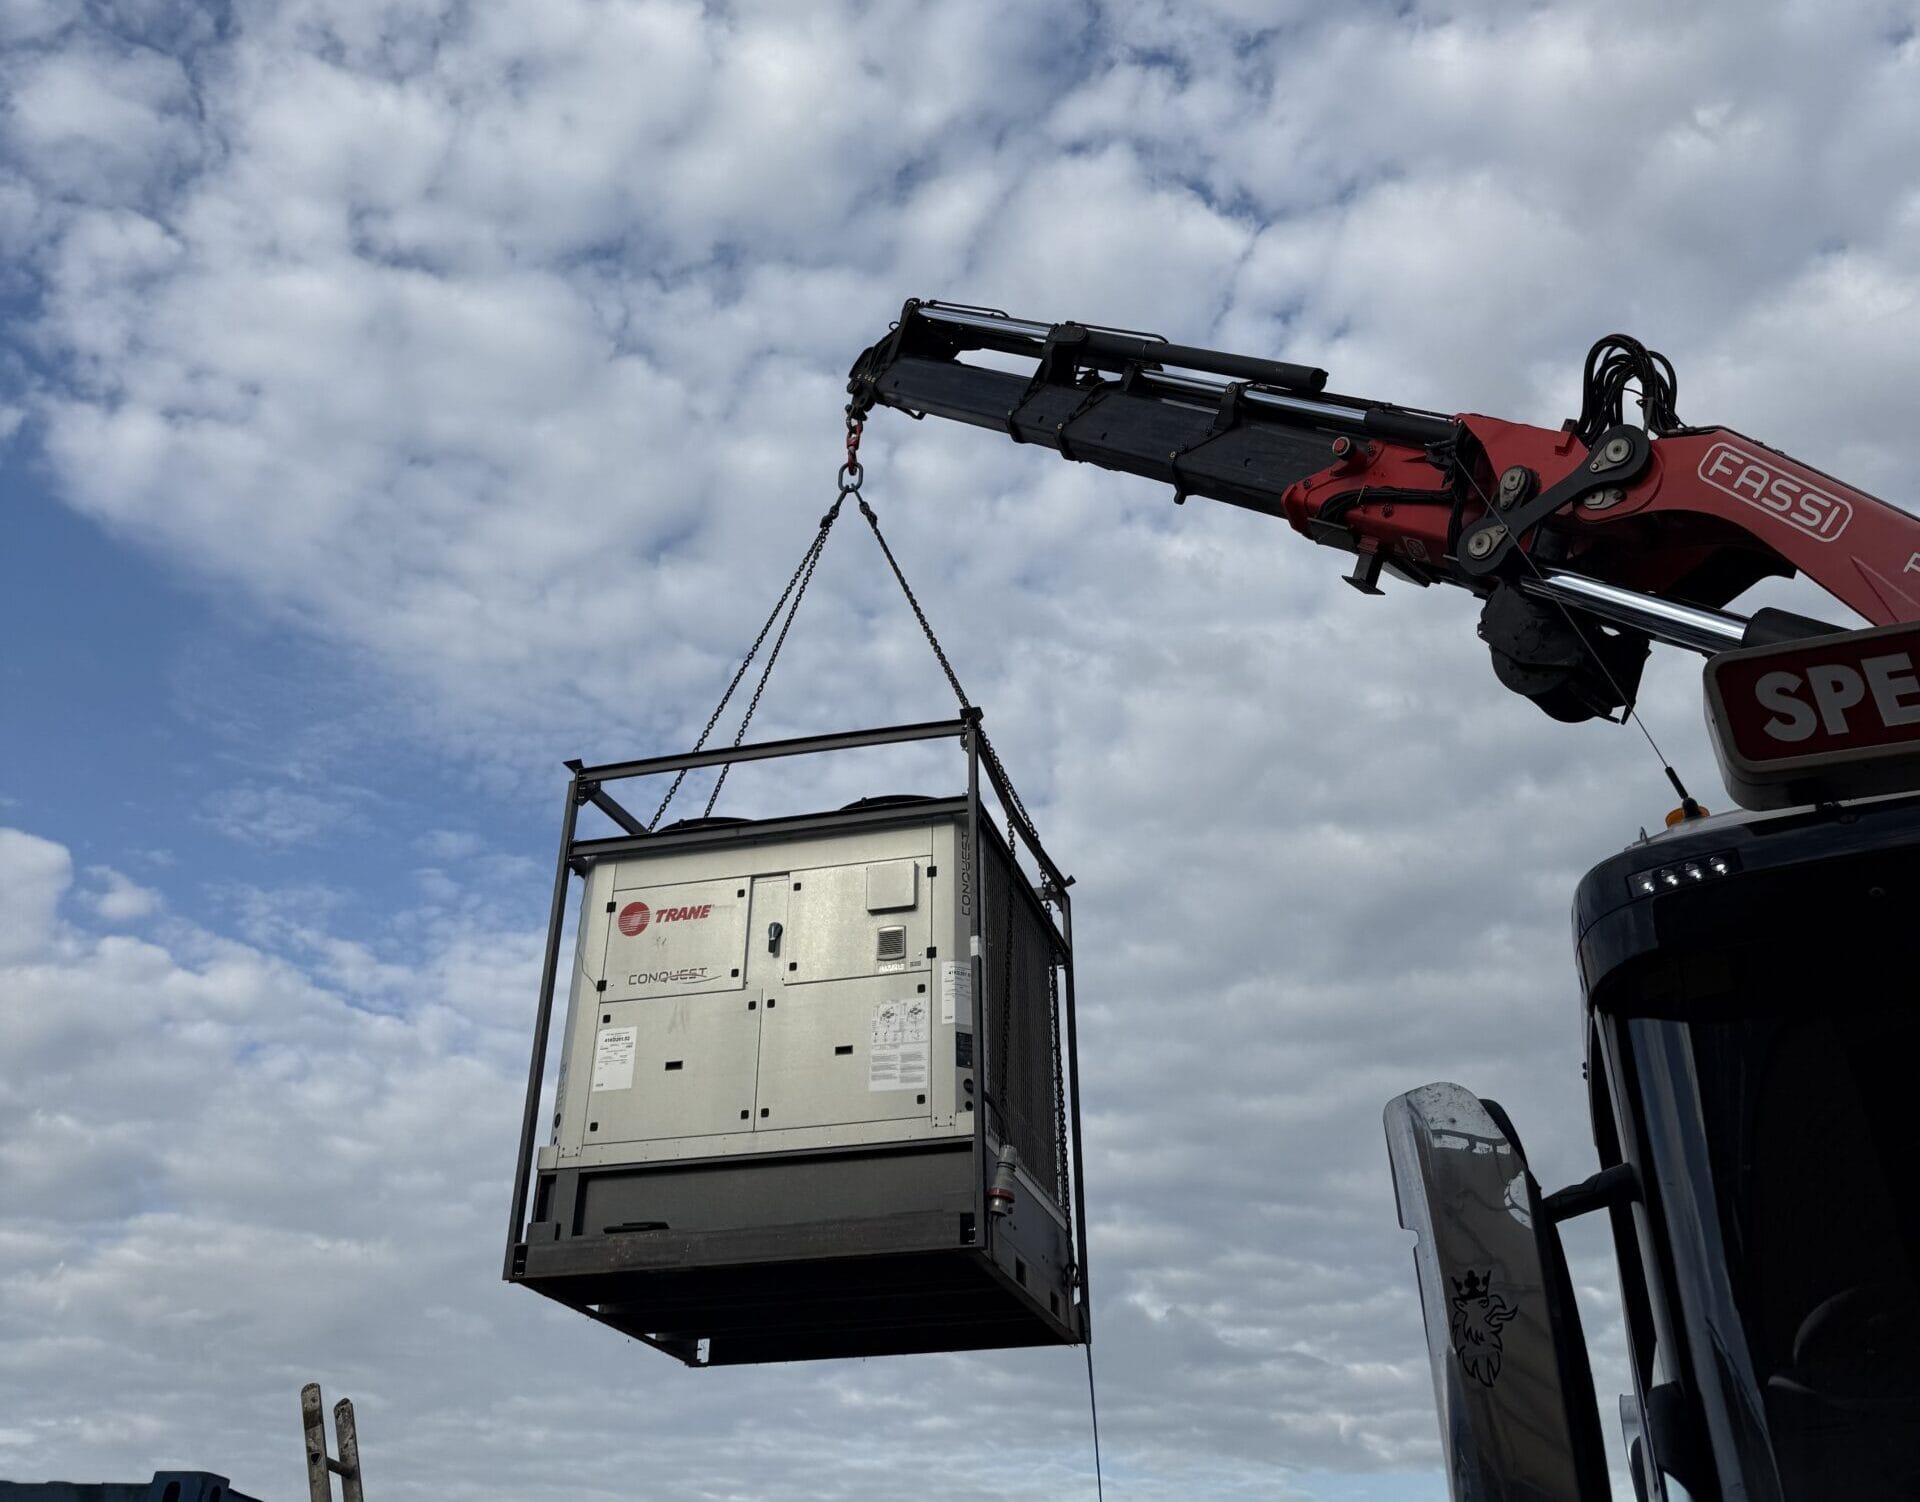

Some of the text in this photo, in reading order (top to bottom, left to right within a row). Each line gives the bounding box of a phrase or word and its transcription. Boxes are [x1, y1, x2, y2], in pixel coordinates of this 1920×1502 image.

[1708, 451, 1841, 533] FASSI
[1754, 652, 1920, 742] SPE
[655, 904, 712, 924] TRANE
[961, 831, 971, 916] CONQUEST
[628, 967, 708, 986] CONQUEST
